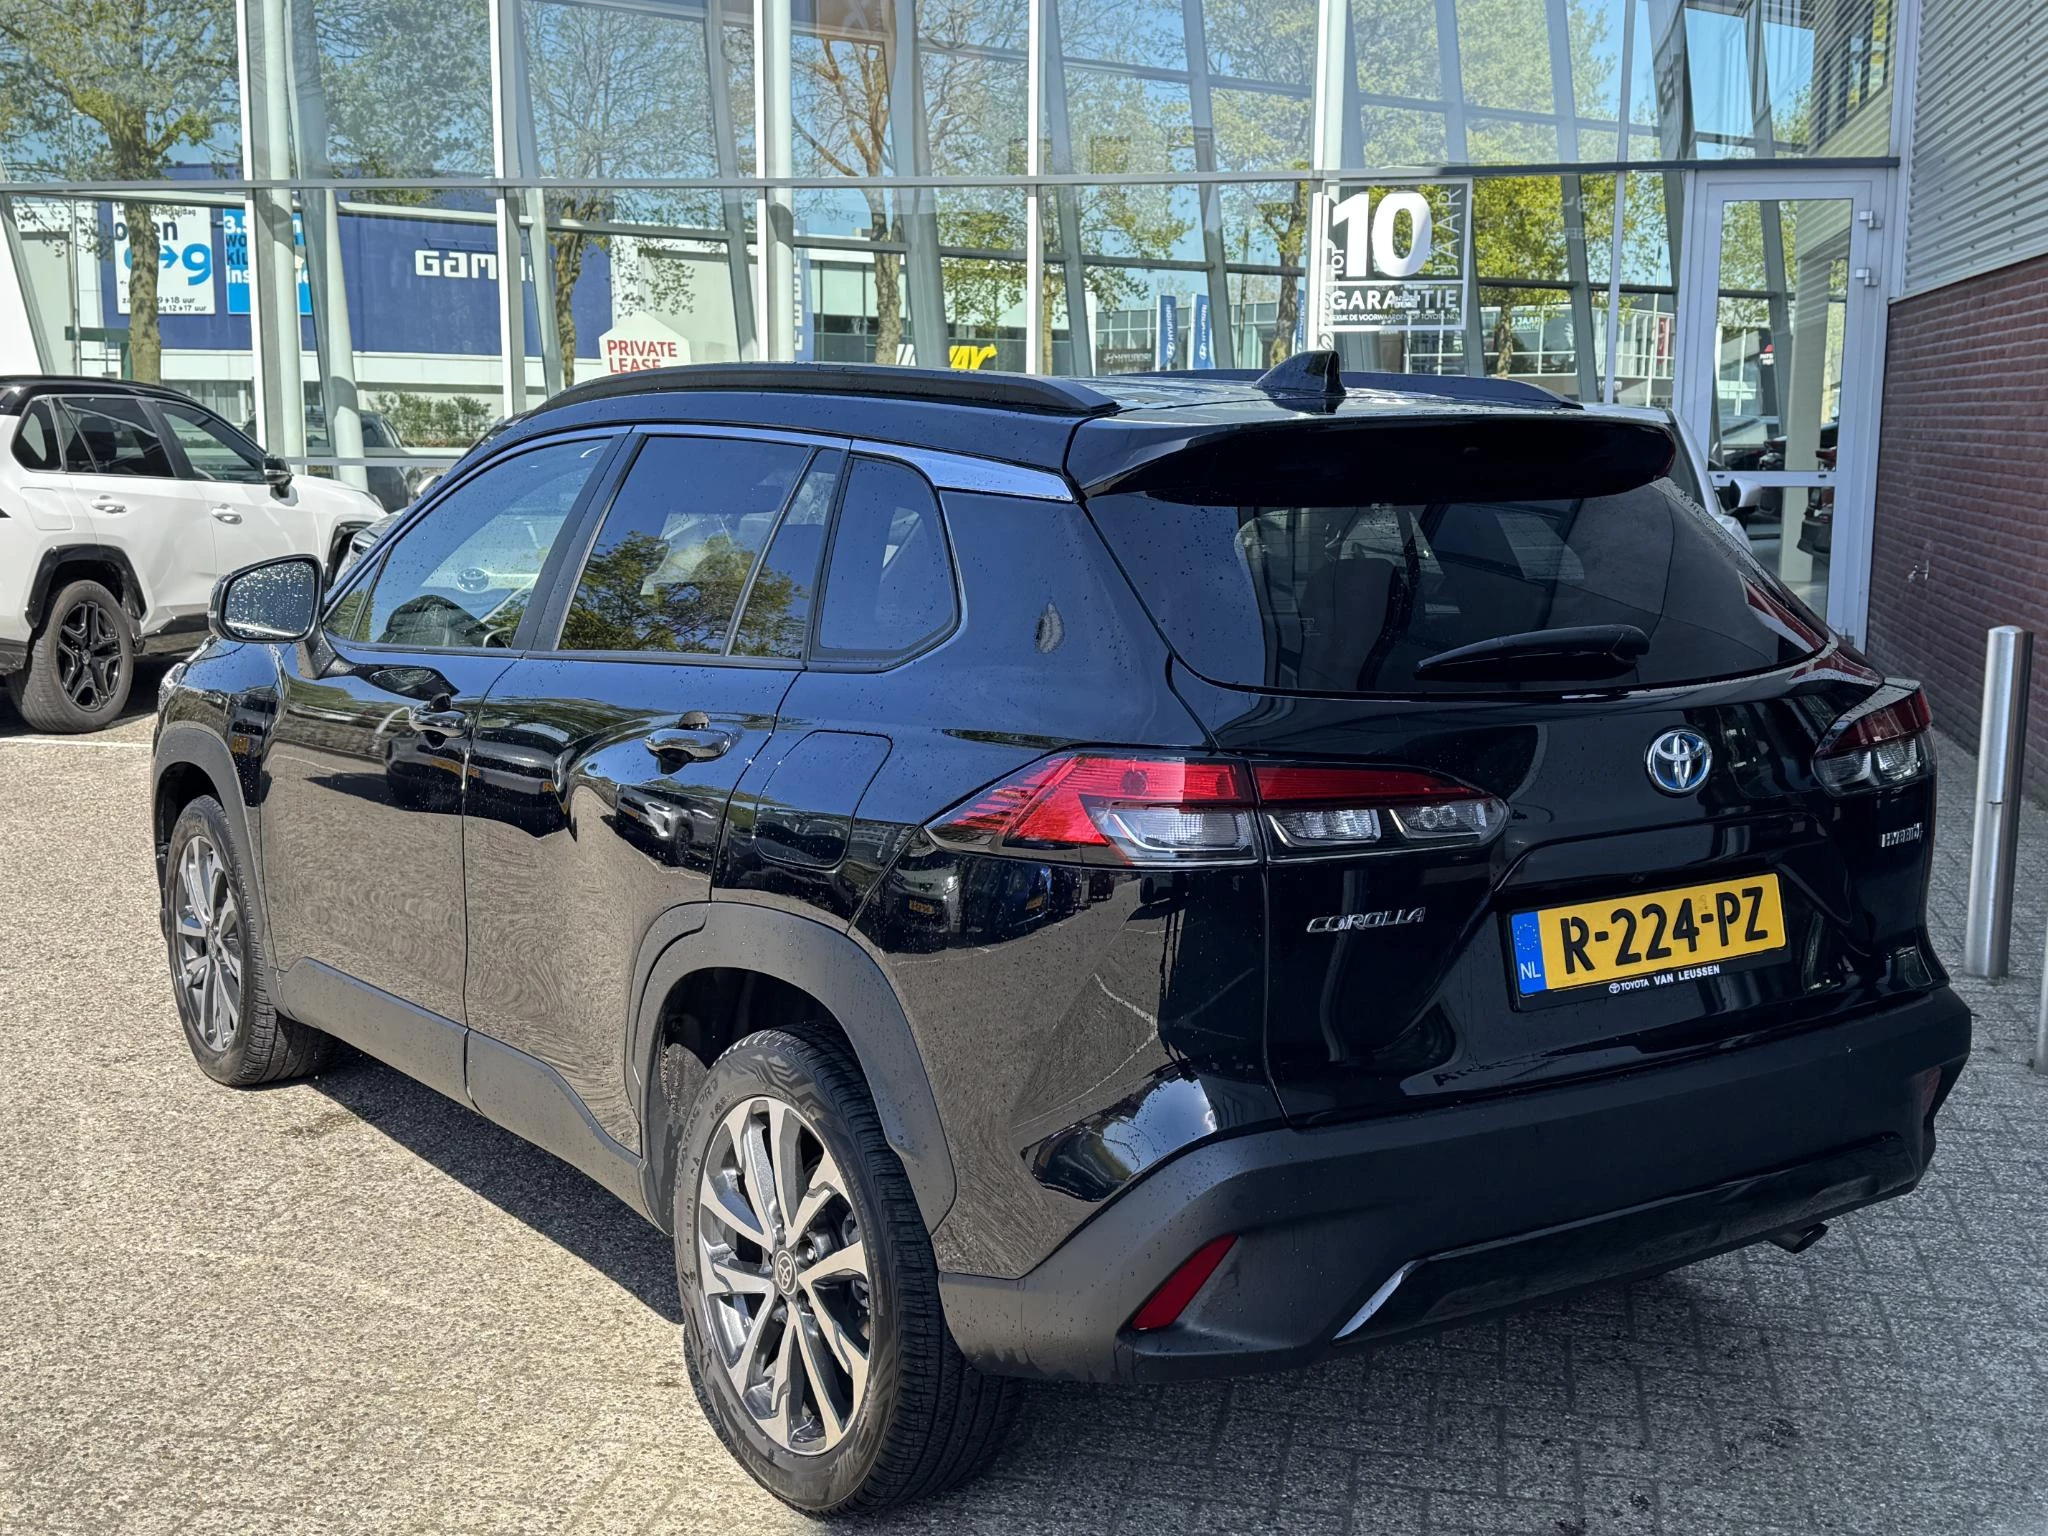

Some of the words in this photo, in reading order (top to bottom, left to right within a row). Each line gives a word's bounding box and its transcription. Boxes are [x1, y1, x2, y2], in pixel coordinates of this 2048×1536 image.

[1333, 190, 1433, 277] 10
[1434, 188, 1462, 276] JAAR
[1331, 249, 1345, 276] TOT
[1330, 289, 1457, 310] GARANTIE
[1166, 304, 1174, 340] HYUNDAI
[607, 339, 677, 358] PRIVATE
[1306, 906, 1426, 933] COROLLA
[1560, 886, 1769, 975] R-224-PZ
[1520, 961, 1541, 981] NL
[1620, 978, 1650, 992] TOYOTA
[1653, 973, 1674, 986] VAN
[1678, 964, 1720, 982] LEUSSEN
